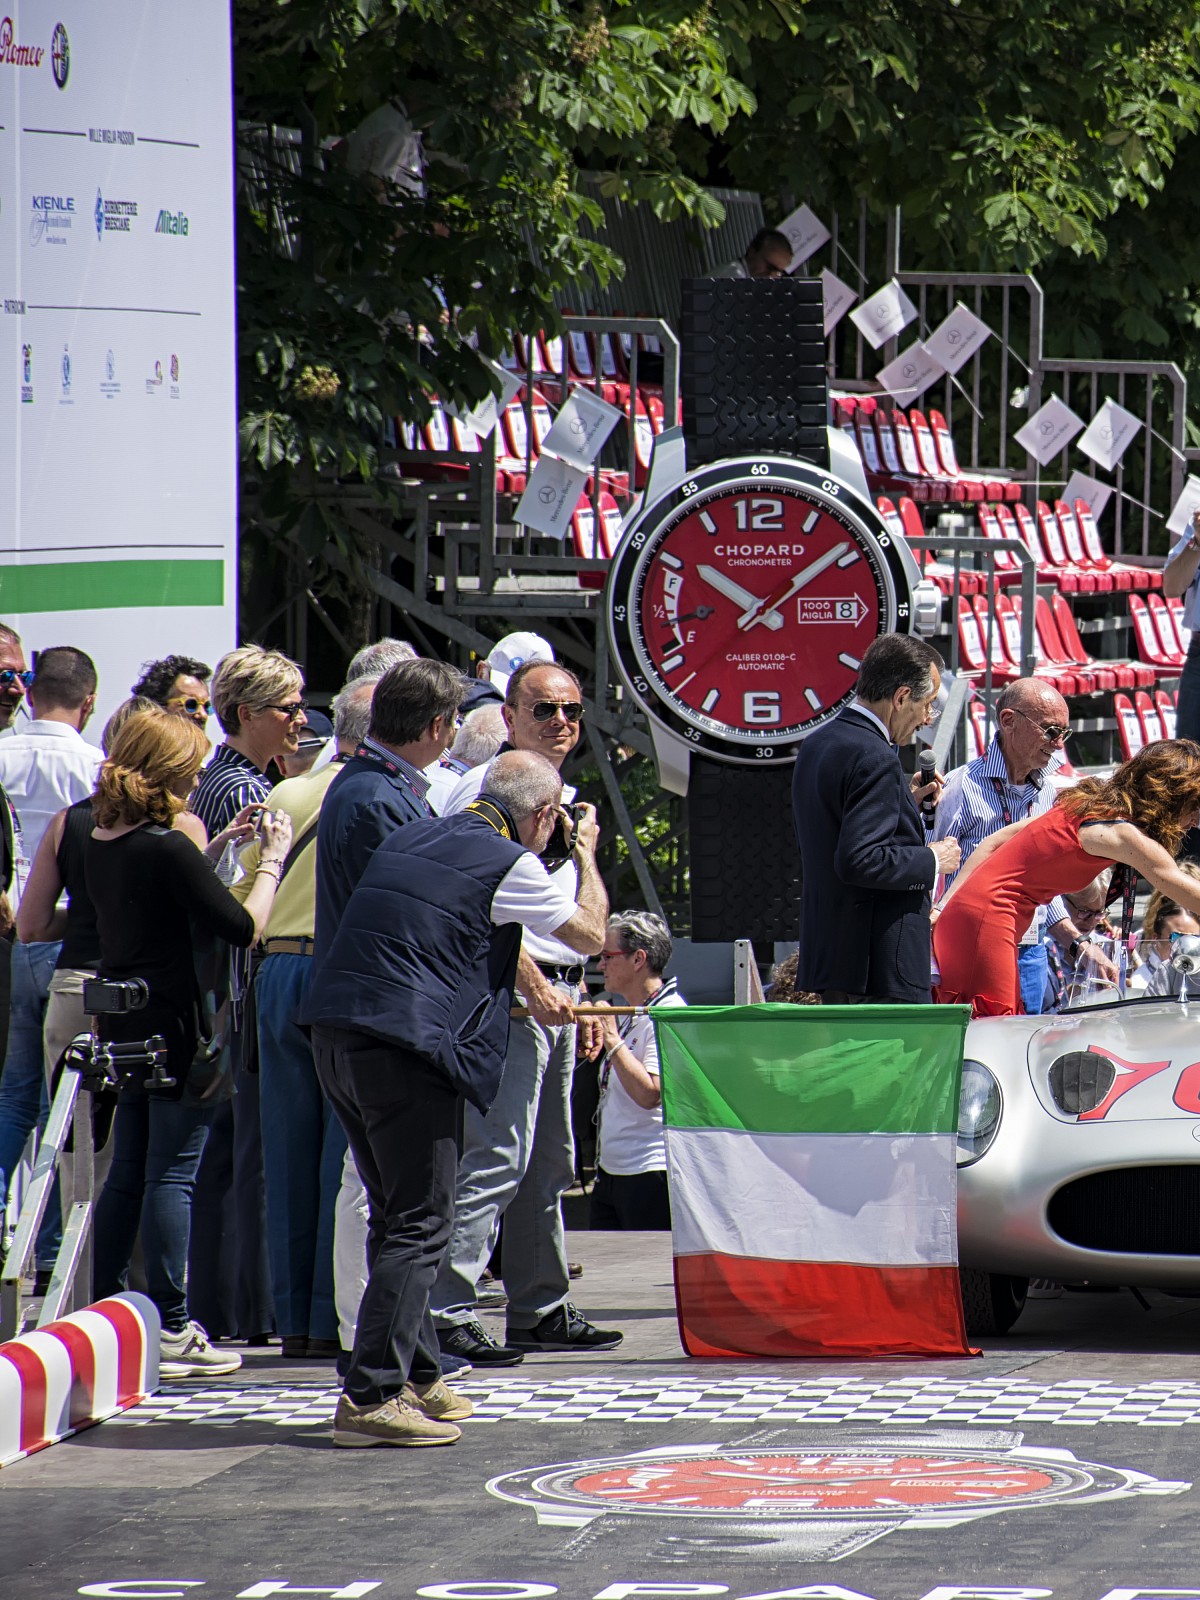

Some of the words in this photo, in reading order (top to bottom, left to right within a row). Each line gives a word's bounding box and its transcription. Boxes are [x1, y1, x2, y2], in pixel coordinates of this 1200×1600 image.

[33, 196, 75, 211] KIENLE
[155, 209, 189, 236] Alitalia
[751, 463, 770, 476] 60
[681, 480, 699, 497] 55
[821, 480, 840, 496] 05
[732, 499, 785, 531] 12
[630, 531, 647, 551] 50
[876, 530, 891, 548] 10
[714, 544, 805, 556] CHOPARD
[727, 558, 792, 567] CHRONOMETER
[669, 577, 677, 589] F
[614, 604, 626, 622] 45
[803, 601, 831, 610] 1000
[840, 602, 853, 618] 8
[897, 602, 909, 618] 15
[801, 611, 833, 620] MIGLIA
[687, 631, 695, 643] E
[725, 653, 761, 662] CALIBER
[762, 653, 797, 662] 01.08-C
[737, 663, 785, 671] AUTOMATIC
[632, 674, 649, 693] 40
[743, 691, 781, 724] 6
[683, 726, 702, 742] 35
[755, 747, 774, 759] 30
